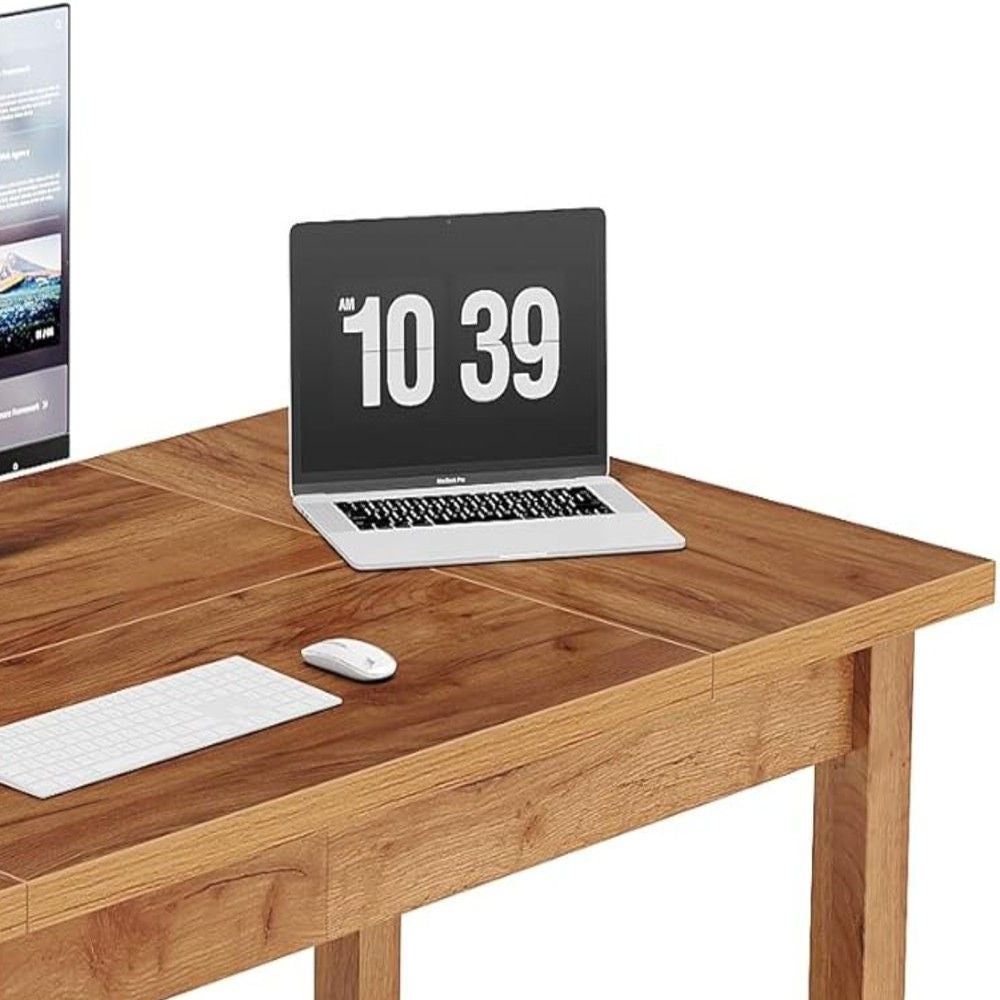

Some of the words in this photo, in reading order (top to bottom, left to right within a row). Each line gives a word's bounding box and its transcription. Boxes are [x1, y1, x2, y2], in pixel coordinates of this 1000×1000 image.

[338, 297, 356, 311] AM
[343, 296, 435, 407] 10
[460, 286, 560, 403] 39
